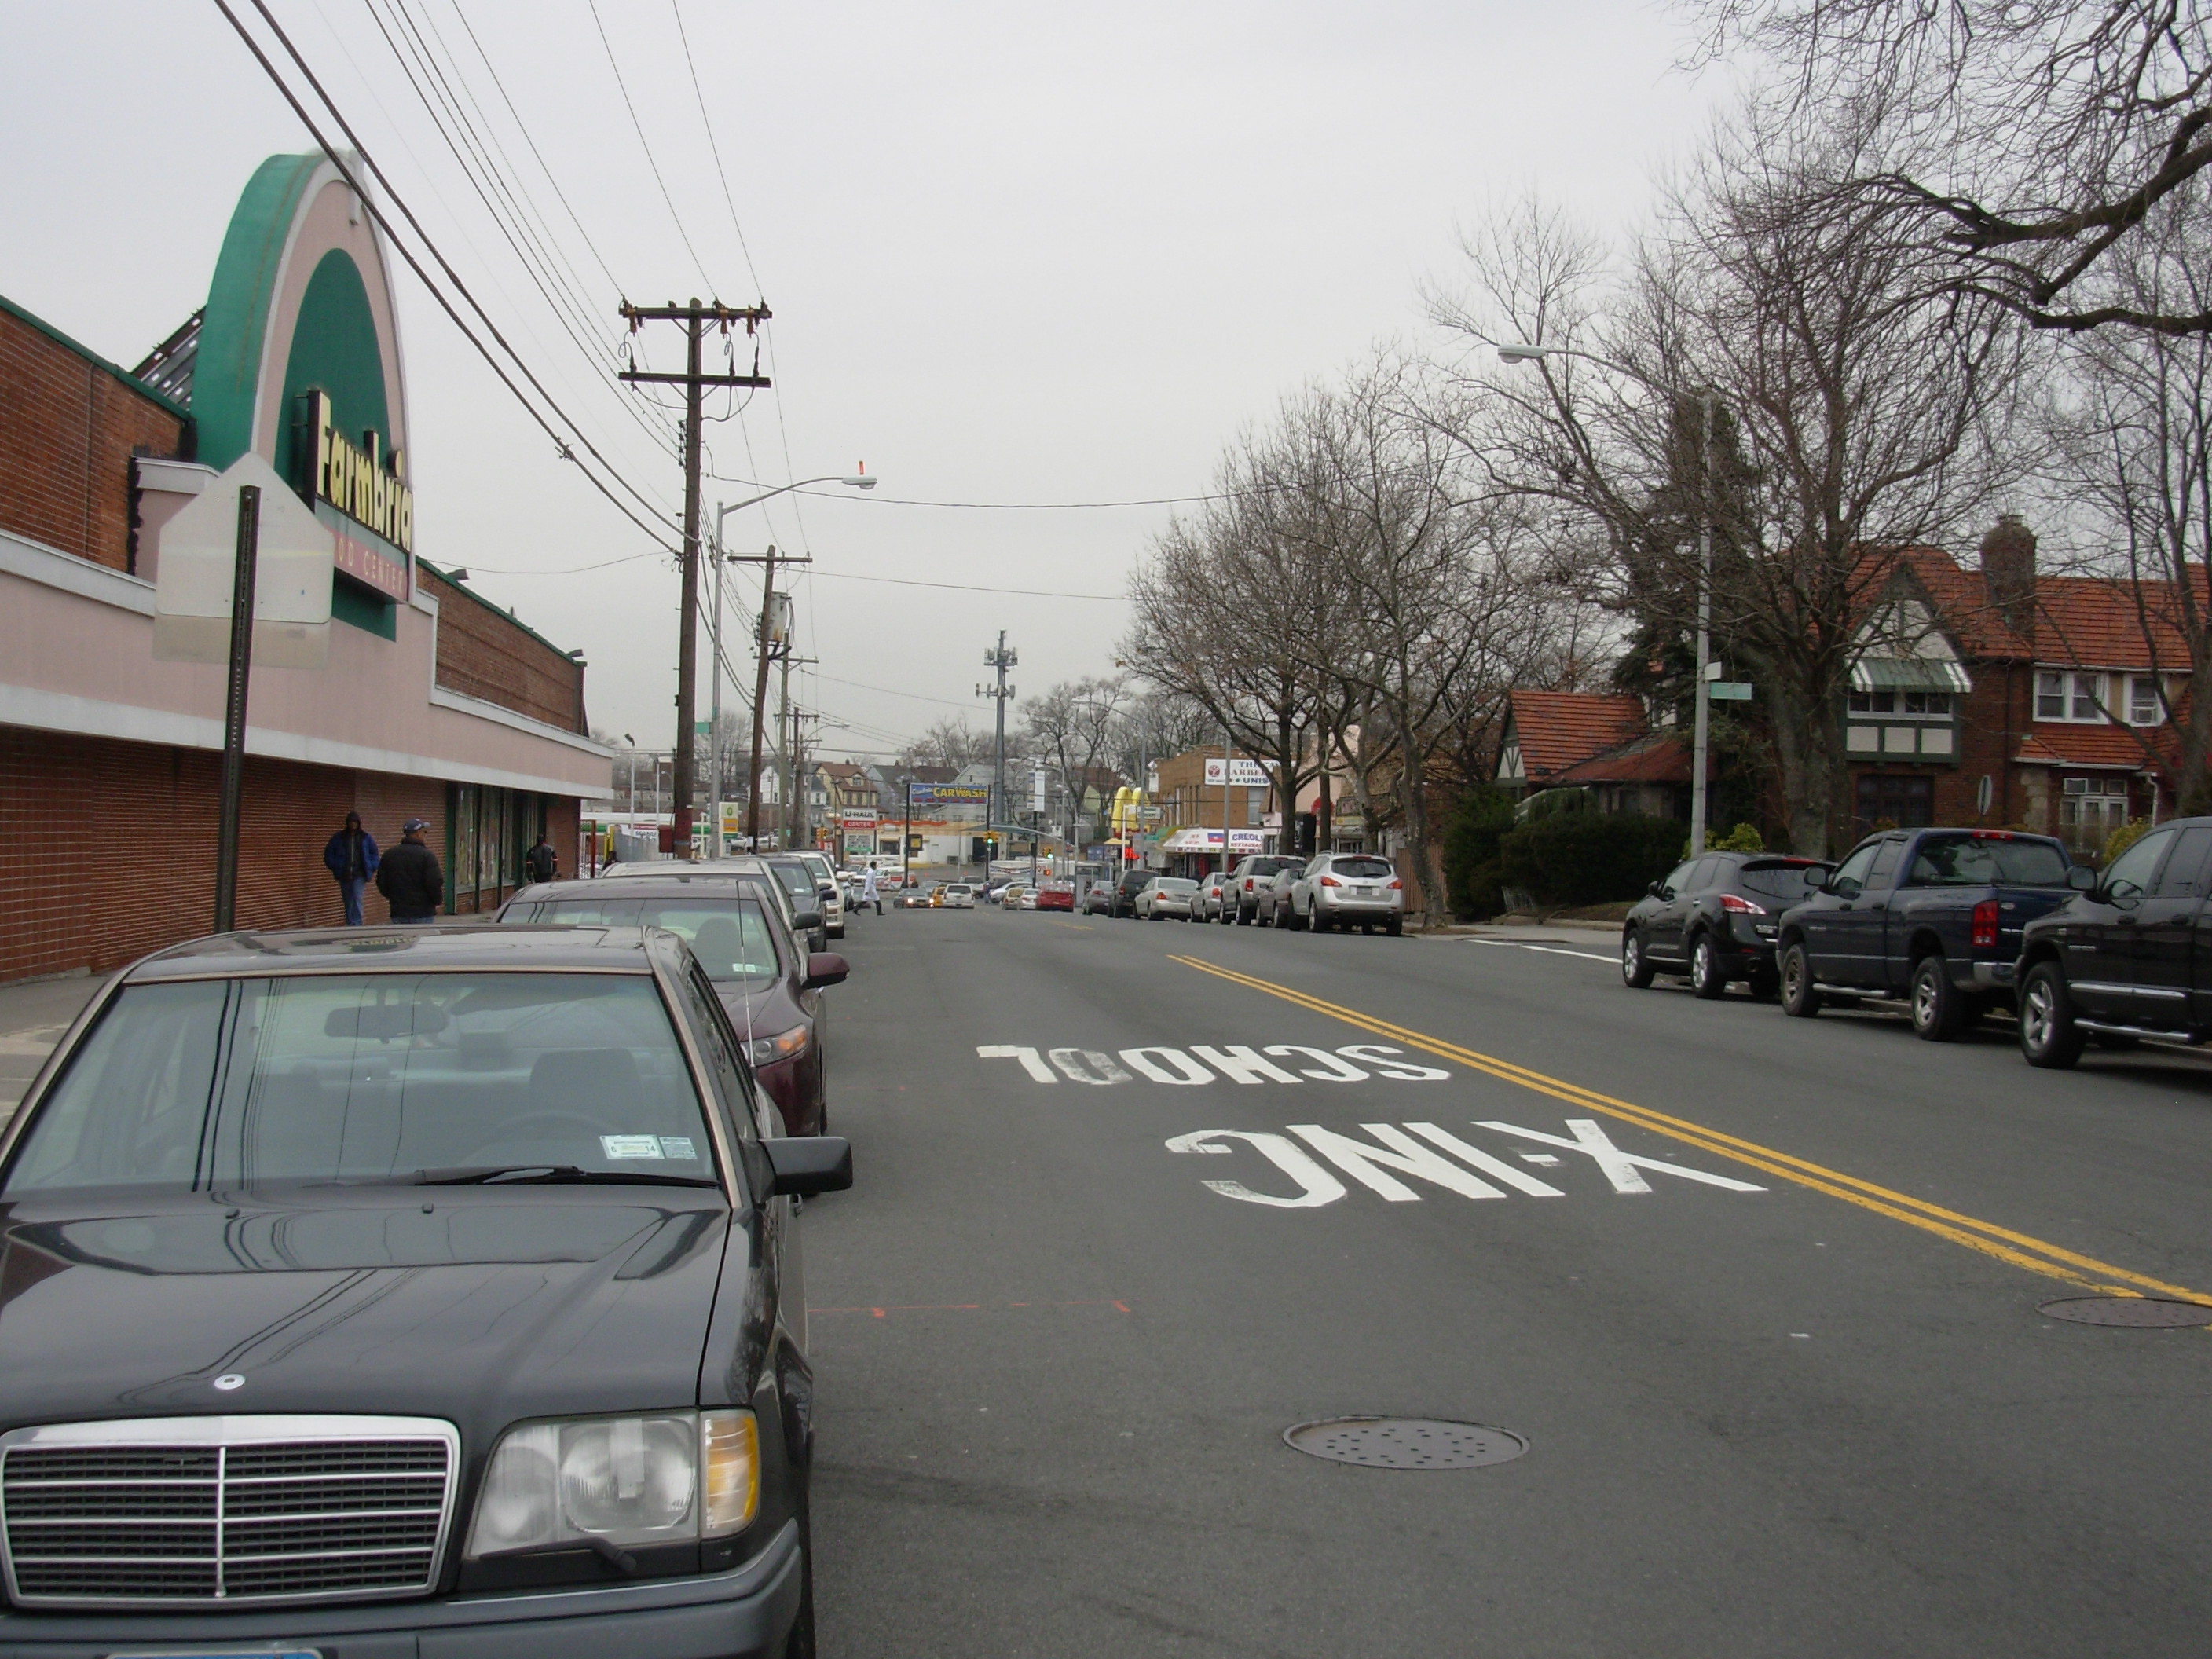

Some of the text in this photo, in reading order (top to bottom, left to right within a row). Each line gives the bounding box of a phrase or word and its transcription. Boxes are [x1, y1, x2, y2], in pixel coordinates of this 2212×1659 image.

[309, 390, 412, 552] Farmbria
[364, 551, 404, 595] CENTER
[977, 1044, 1452, 1087] SCHOOL
